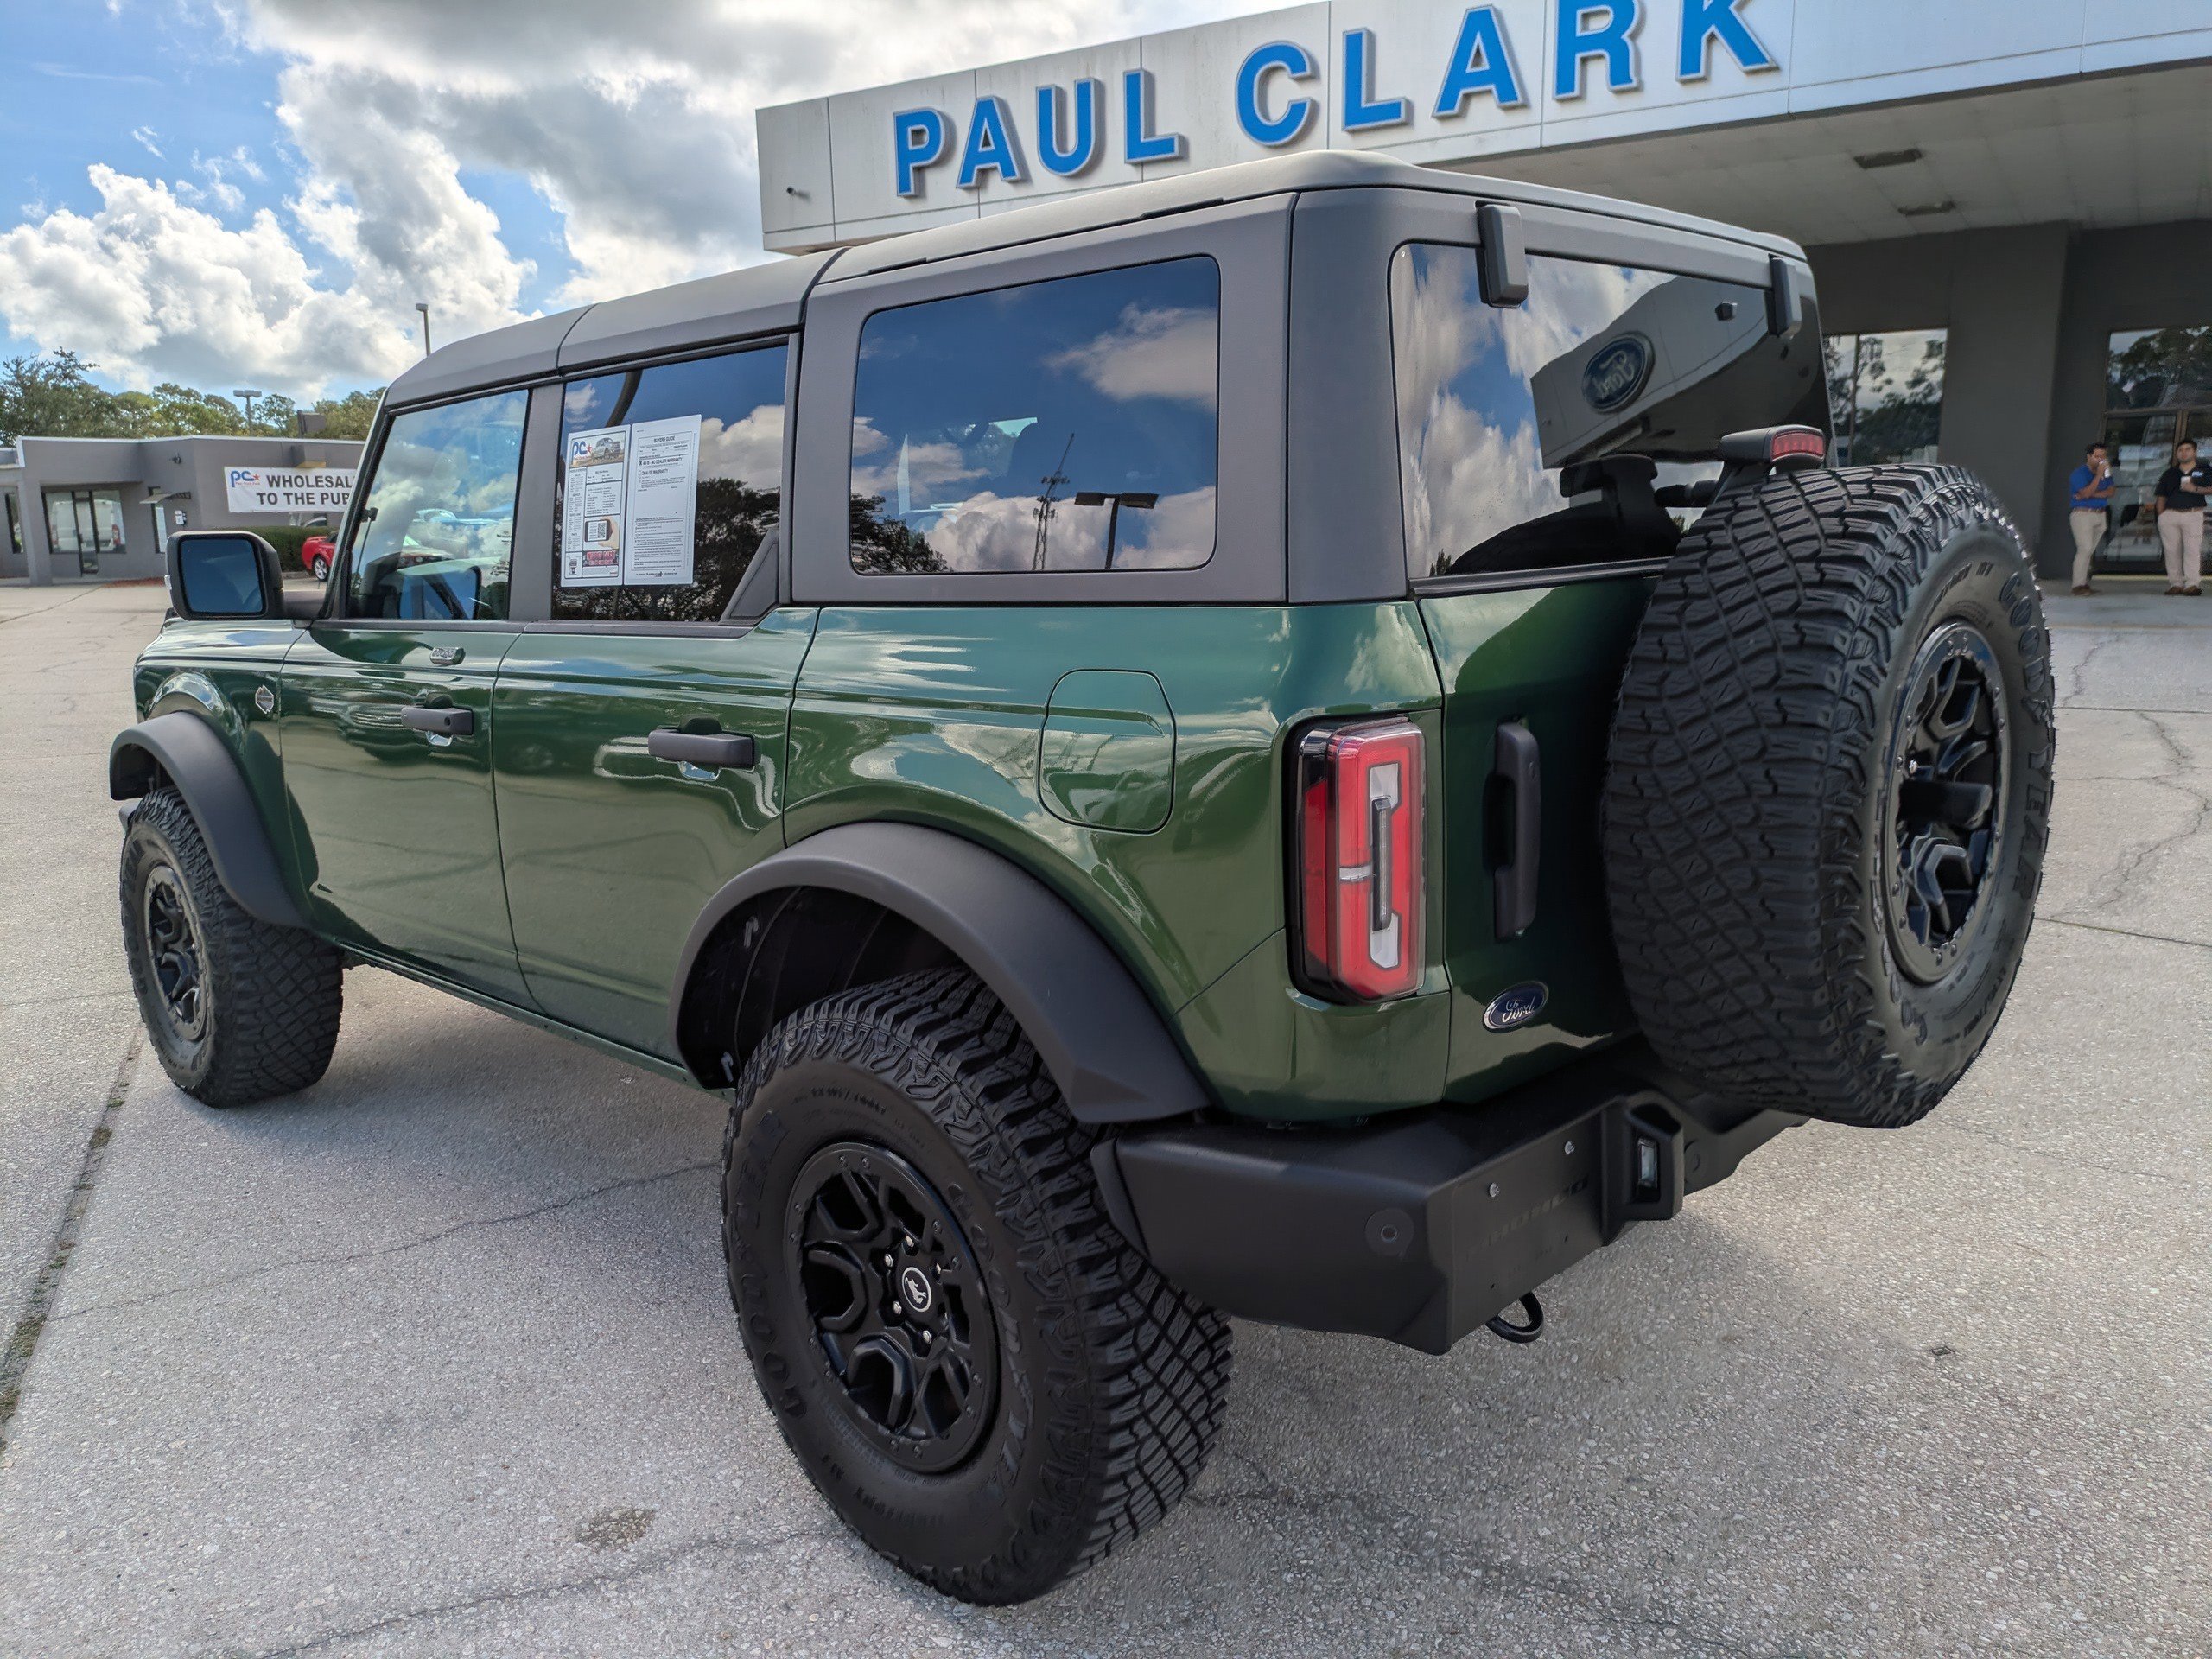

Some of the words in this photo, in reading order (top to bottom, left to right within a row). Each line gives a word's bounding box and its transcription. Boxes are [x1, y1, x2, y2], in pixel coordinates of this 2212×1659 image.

[893, 70, 1180, 196] PAUL
[1236, 0, 1779, 145] CLARK
[256, 493, 278, 505] TO
[283, 493, 315, 505] THE
[266, 475, 355, 488] WHOLESAL
[1999, 570, 2052, 900] GOODYEAR
[1502, 995, 1535, 1023] Ford
[948, 1181, 1034, 1514] GOODYE
